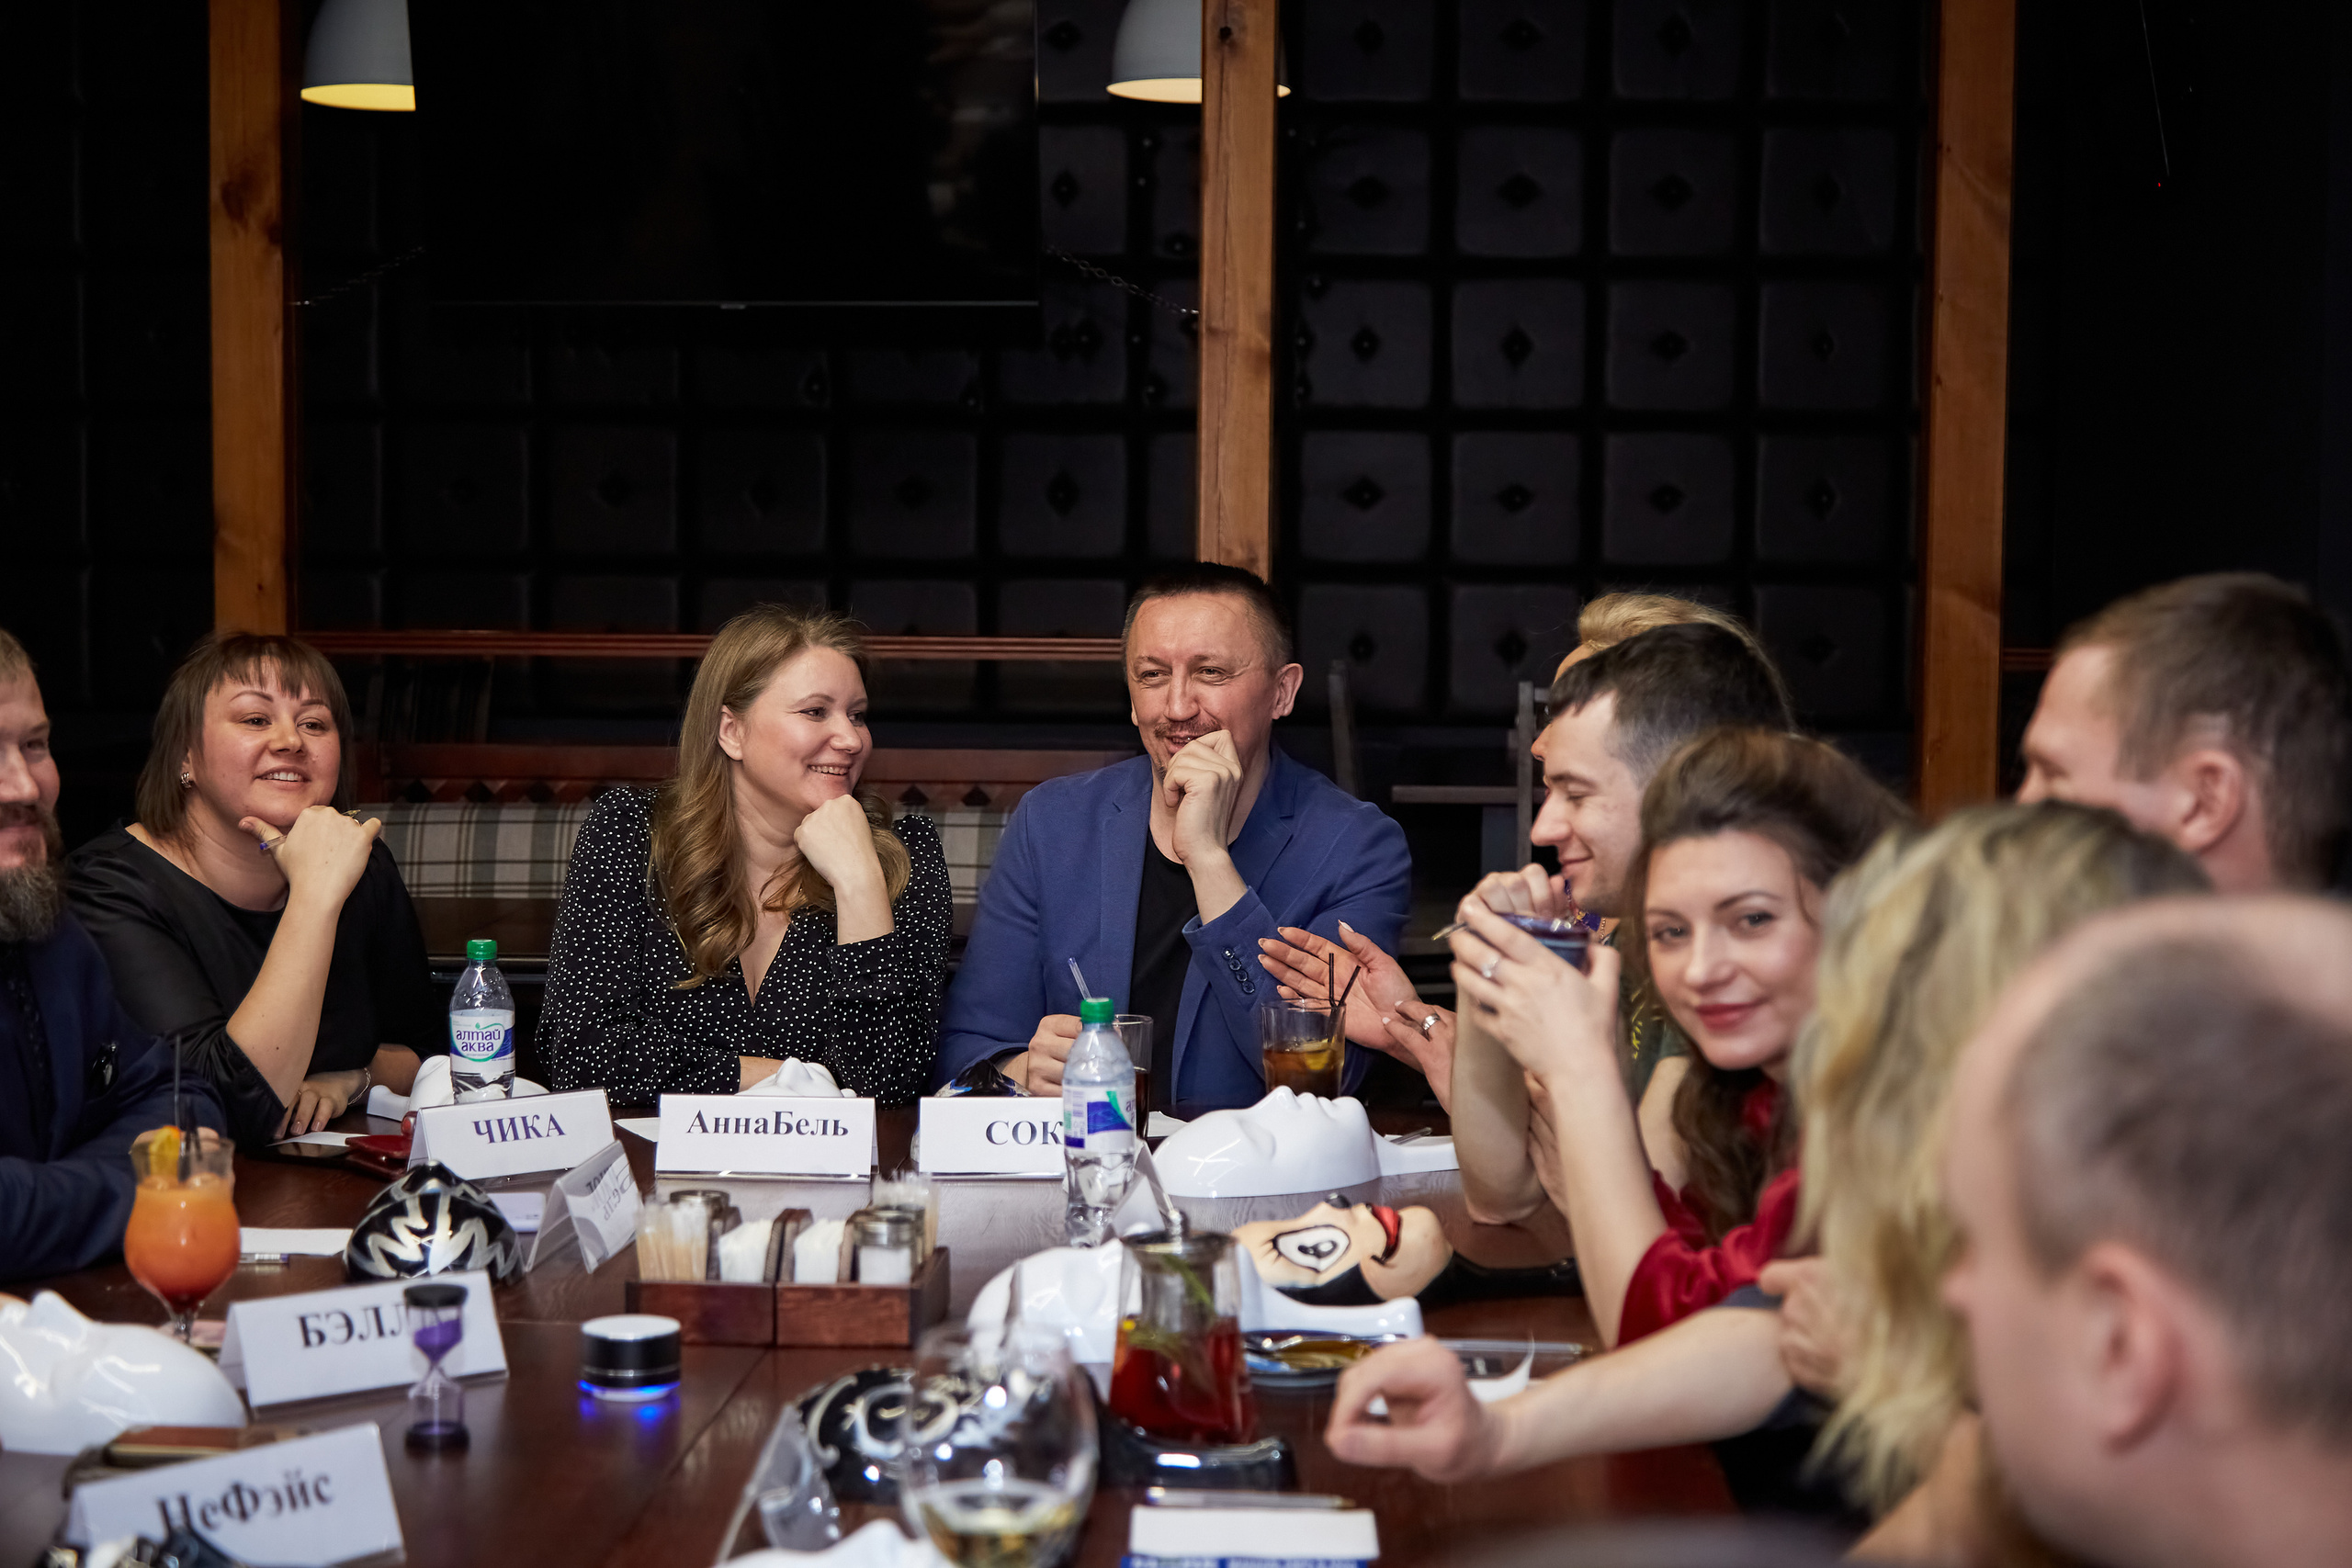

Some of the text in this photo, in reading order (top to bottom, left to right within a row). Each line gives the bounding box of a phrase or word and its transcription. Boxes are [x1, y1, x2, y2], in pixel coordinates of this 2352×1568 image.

[456, 1029, 501, 1041] алтай
[461, 1041, 494, 1052] аква
[471, 1112, 566, 1144] ЧИКА
[686, 1109, 849, 1136] АннаБель
[985, 1120, 1064, 1145] СОК
[297, 1303, 412, 1349] БЭЛЛ
